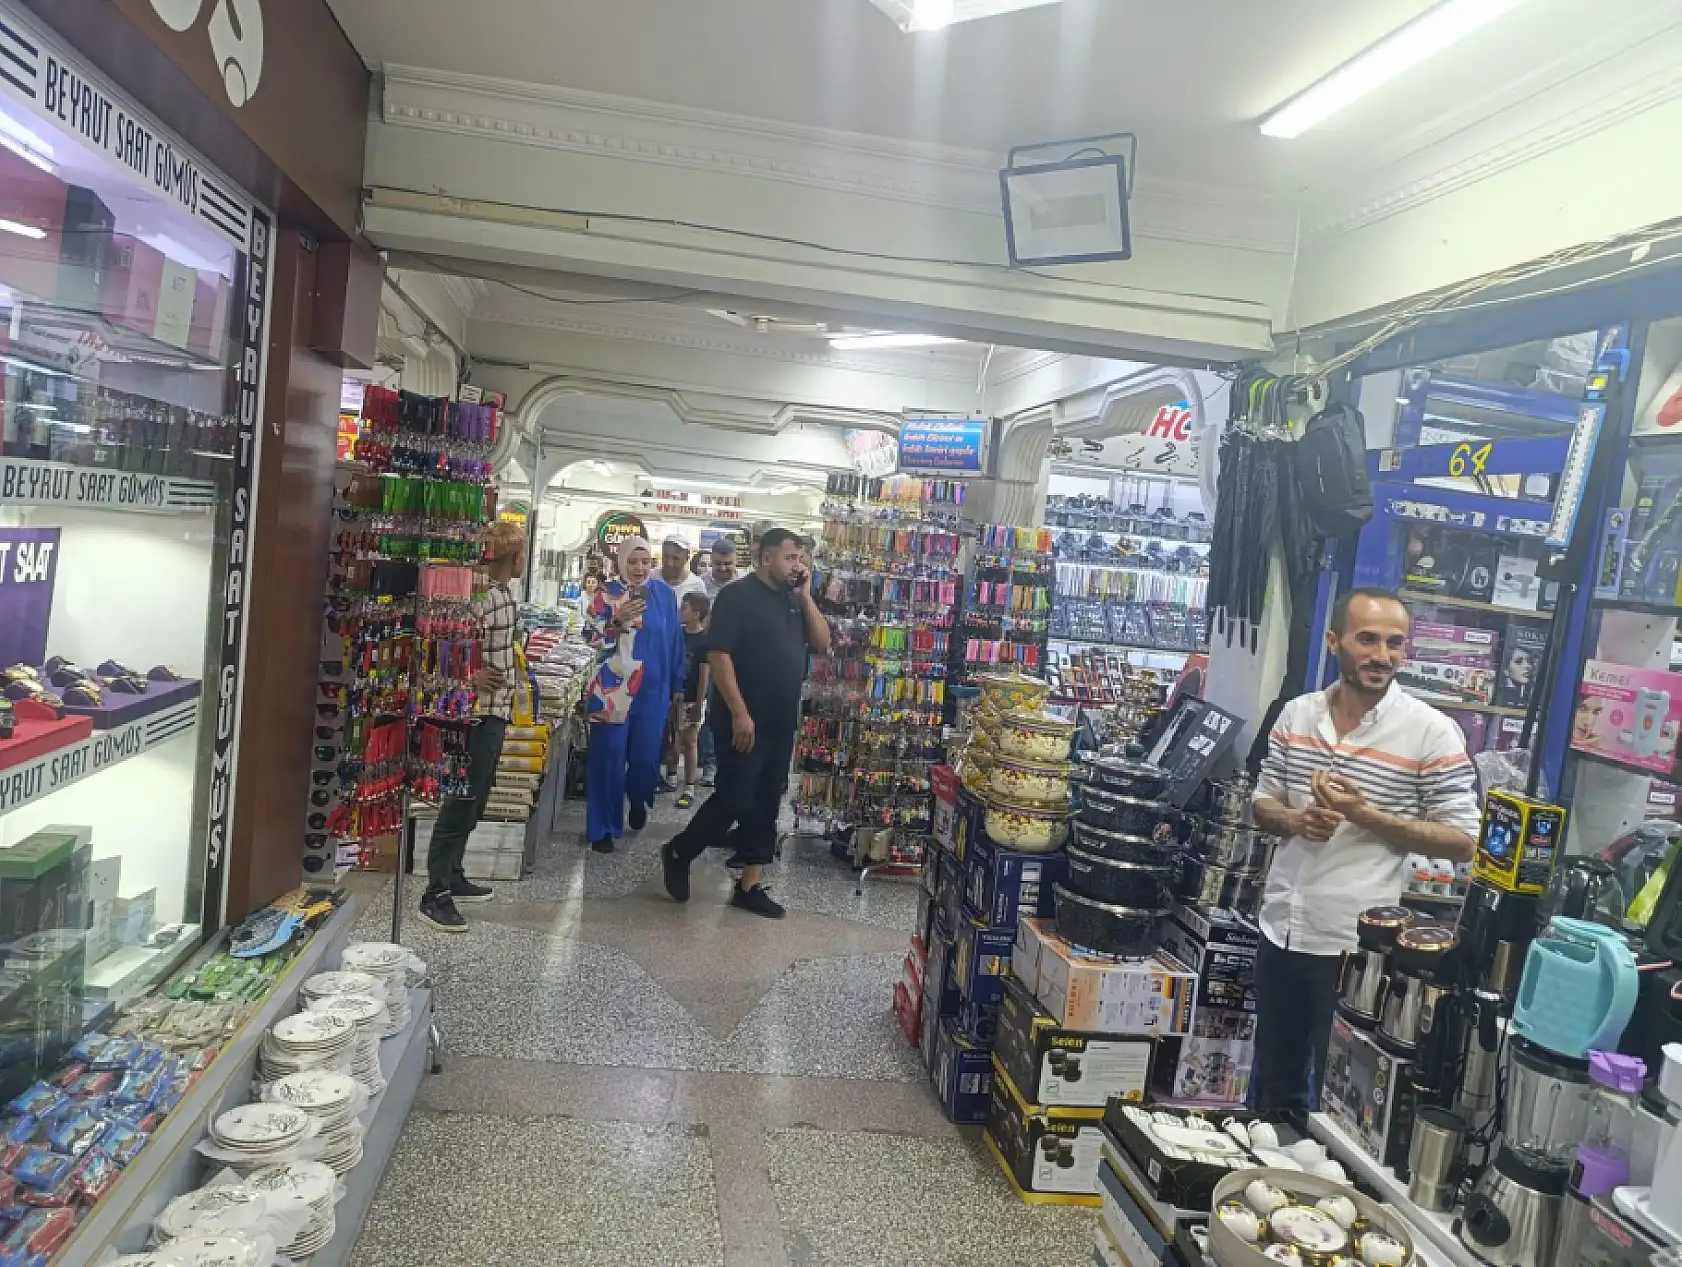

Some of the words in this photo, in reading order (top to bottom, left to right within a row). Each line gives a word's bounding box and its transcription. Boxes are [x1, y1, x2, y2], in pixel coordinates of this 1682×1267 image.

[44, 56, 113, 150] BEYRUT
[115, 112, 153, 178] SAAT
[154, 142, 199, 214] GÜMÜŞ
[238, 217, 266, 468] BEYRUT
[3, 465, 74, 499] BEYRUT
[77, 472, 116, 502] SAAT
[14, 542, 55, 583] SAAT
[225, 487, 248, 646] SAAT
[50, 745, 91, 788] SAAT
